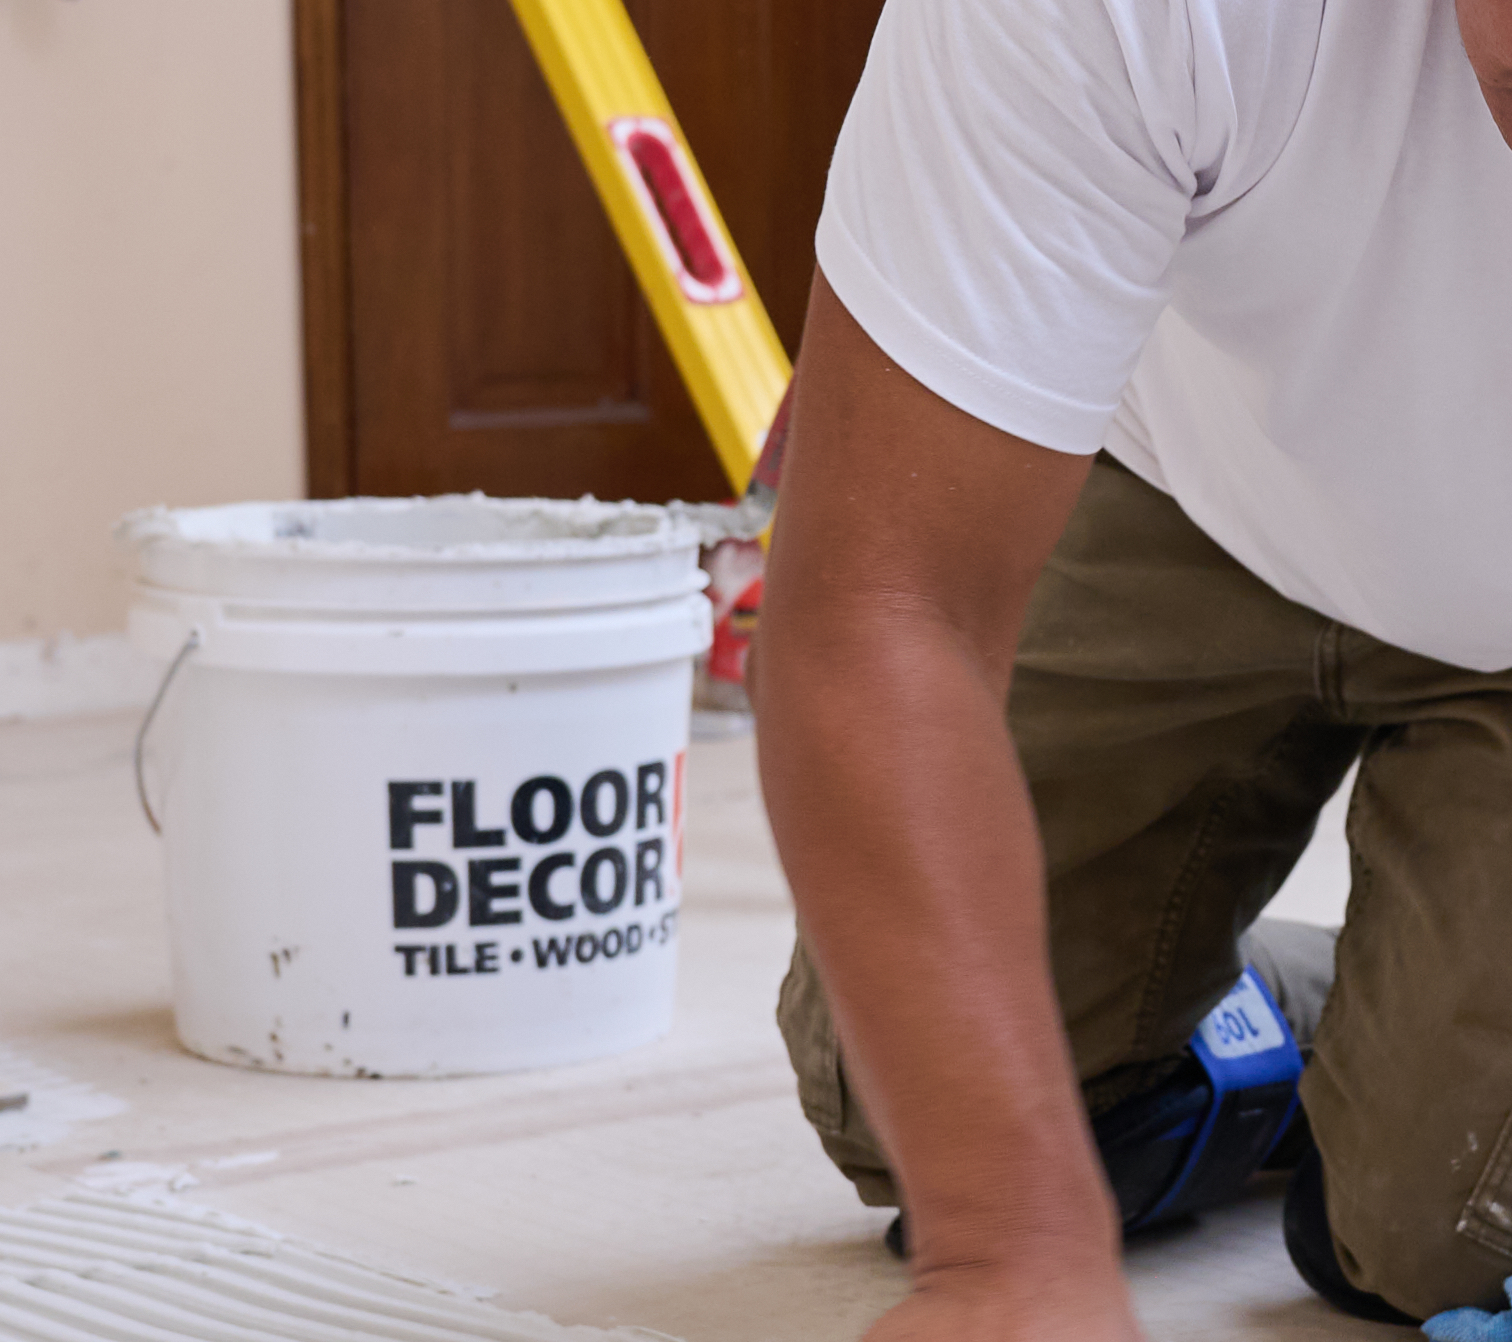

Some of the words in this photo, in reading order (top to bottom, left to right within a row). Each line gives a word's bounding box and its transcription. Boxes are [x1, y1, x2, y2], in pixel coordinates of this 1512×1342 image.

[387, 760, 665, 850] FLOOR
[392, 837, 664, 929] DECOR
[394, 941, 500, 976] TILE
[532, 923, 642, 970] WOOD
